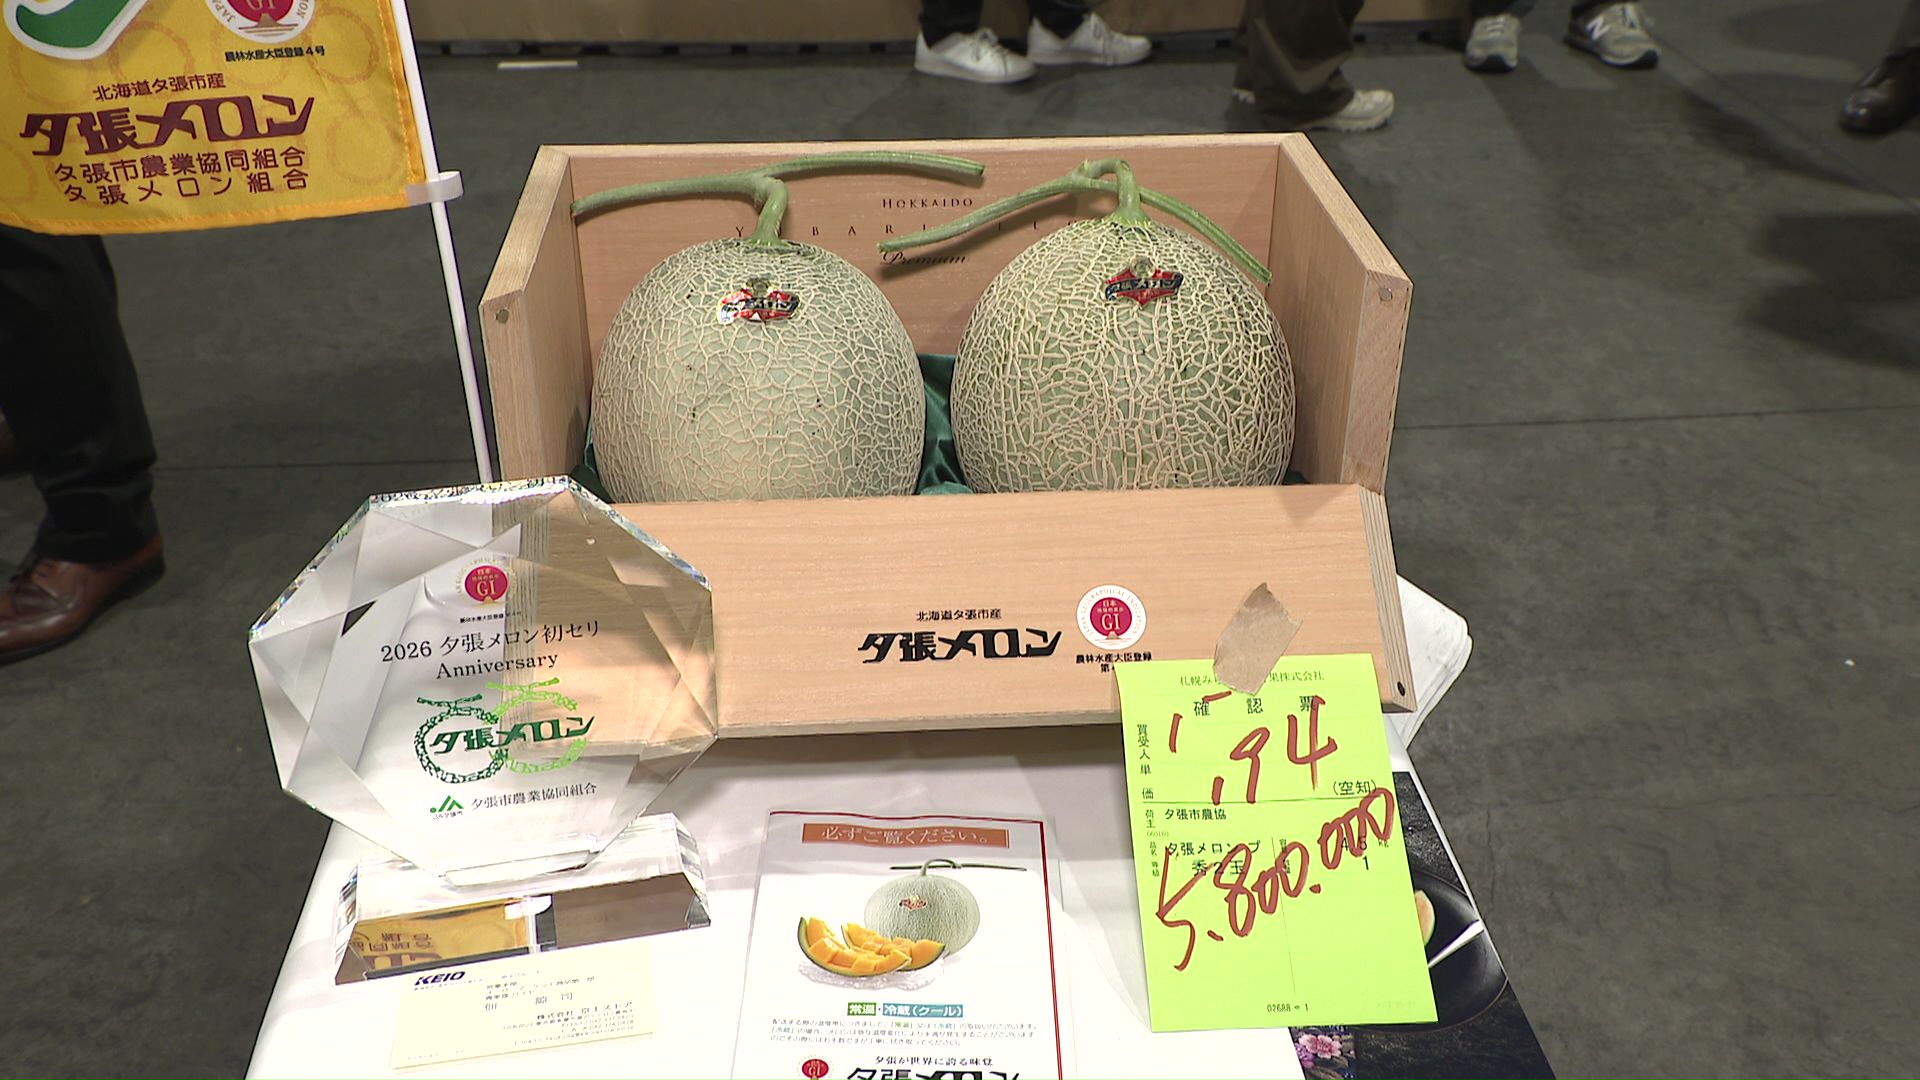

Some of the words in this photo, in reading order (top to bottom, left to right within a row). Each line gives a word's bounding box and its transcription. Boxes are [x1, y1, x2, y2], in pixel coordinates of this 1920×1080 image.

[93, 72, 226, 102] 北海道夕張市産
[19, 94, 315, 157] 夕張メロン
[55, 146, 306, 185] 夕張市農業協同組合
[64, 169, 309, 206] 夕張メロン組合
[882, 197, 973, 209] HOKKAIDO
[477, 580, 497, 597] GI
[916, 608, 1002, 621] 北海道夕張市産
[1101, 613, 1121, 631] GI
[381, 641, 432, 662] 2026
[439, 621, 599, 656] 夕張メロン初セリ
[857, 628, 1063, 663] 夕張メロン
[436, 654, 558, 679] Anniversary
[430, 716, 595, 754] 夕張メロン
[471, 782, 597, 811] 夕張市農業協同組合
[1164, 808, 1227, 821] 夕張市農協
[822, 827, 988, 844] 必ずご覧ください。
[415, 971, 465, 986] KEIO
